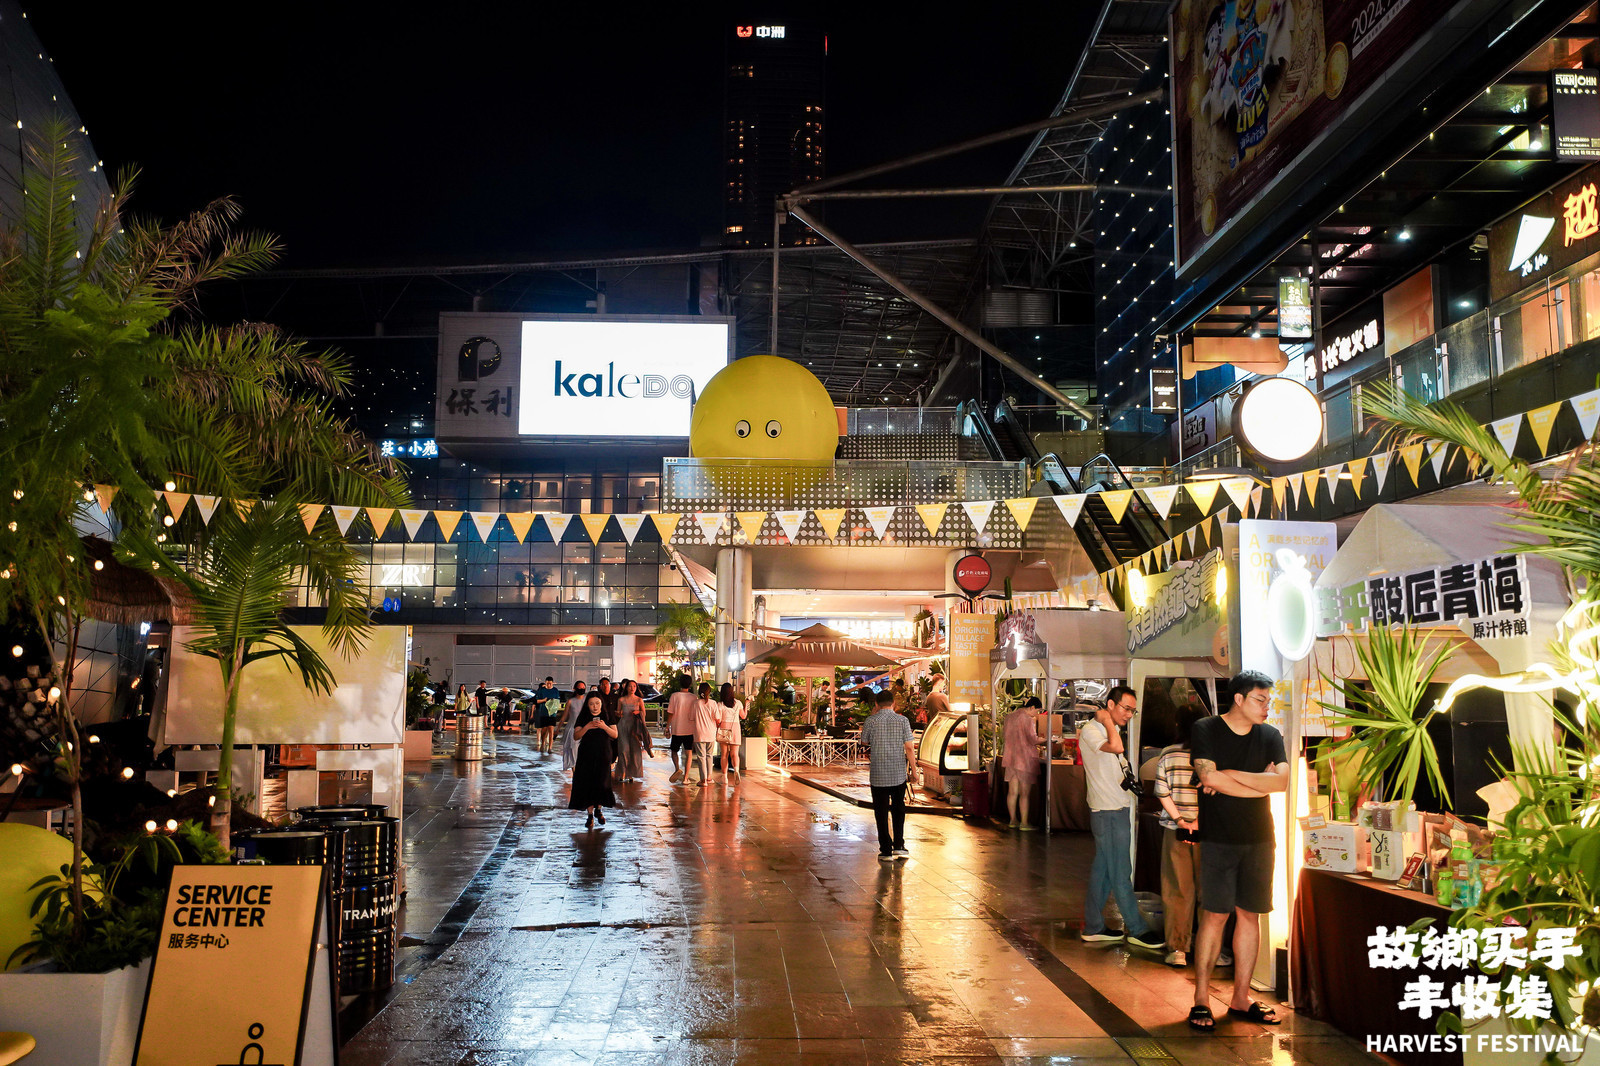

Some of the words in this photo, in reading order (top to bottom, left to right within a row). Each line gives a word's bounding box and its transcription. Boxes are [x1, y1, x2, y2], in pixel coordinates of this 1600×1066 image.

[756, 26, 785, 38] 中洲
[445, 386, 512, 418] 保利
[954, 626, 990, 635] ORIGINAL
[1472, 617, 1528, 640] 原汁特酿
[954, 634, 985, 643] VILLAGE
[954, 642, 978, 650] TASTE
[954, 649, 972, 657] TRIP
[176, 884, 273, 905] SERVICE
[172, 906, 266, 927] CENTER
[344, 908, 379, 921] TRAM
[168, 933, 230, 949] 服务中心
